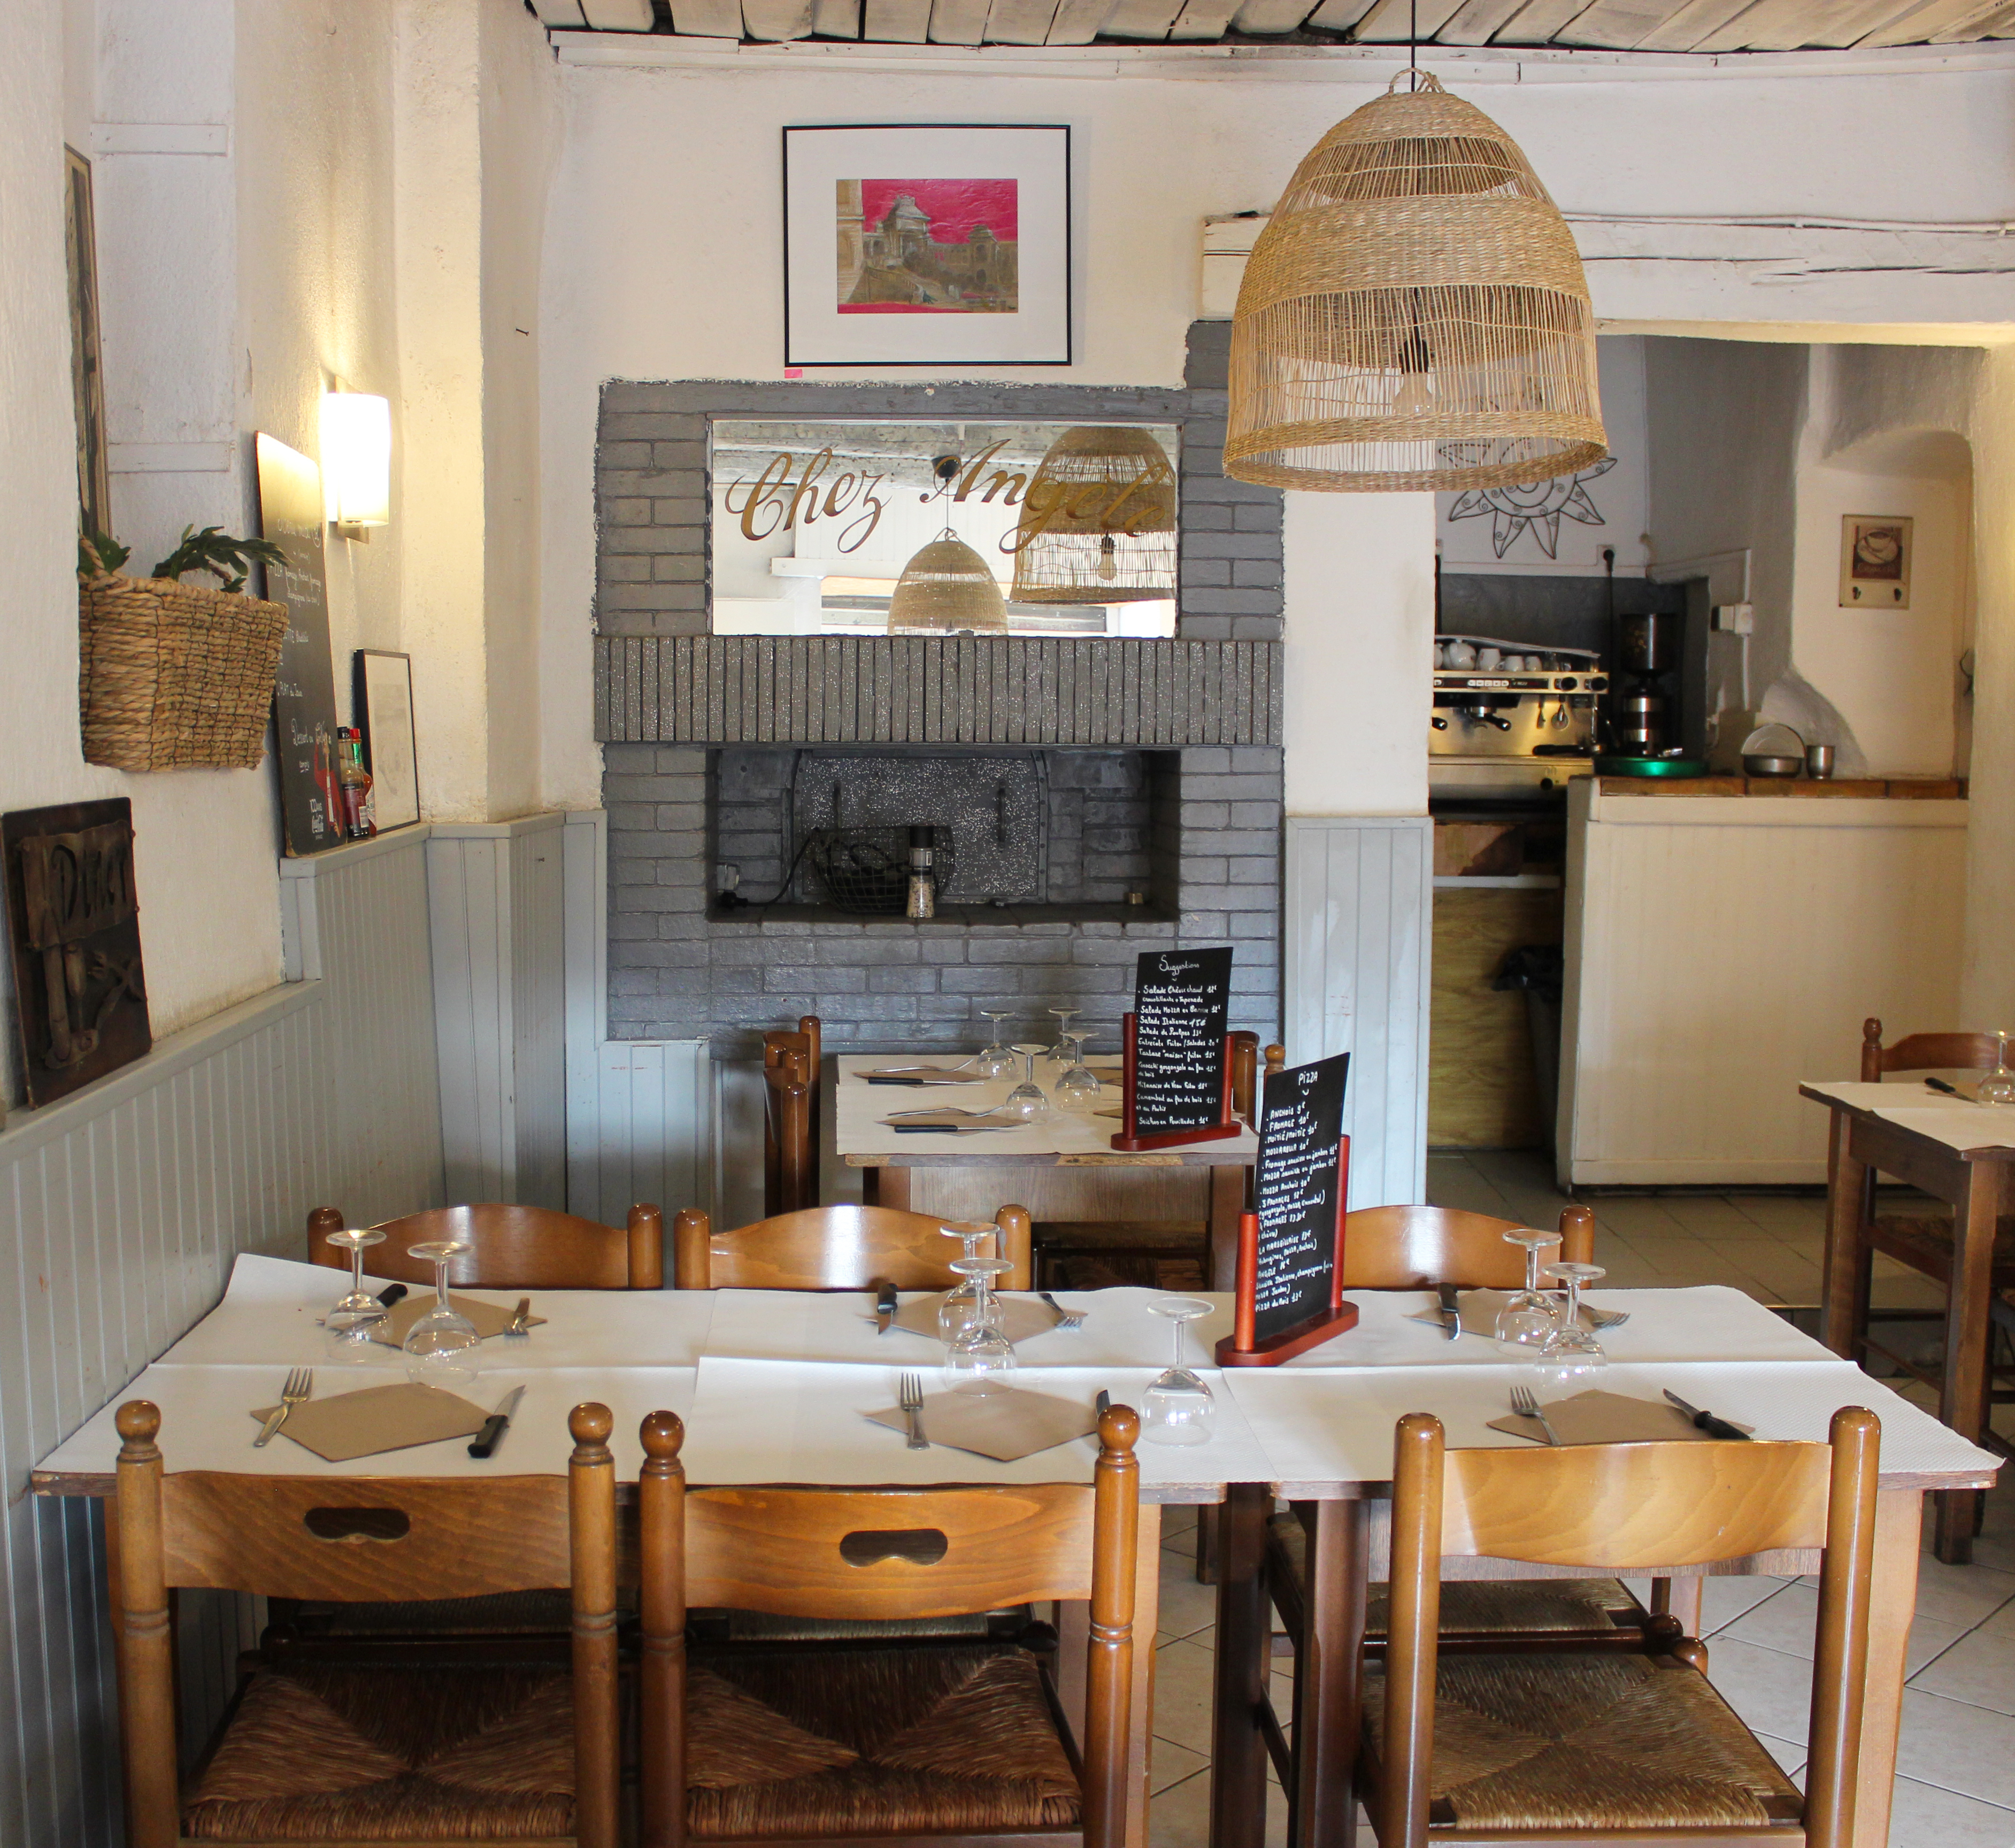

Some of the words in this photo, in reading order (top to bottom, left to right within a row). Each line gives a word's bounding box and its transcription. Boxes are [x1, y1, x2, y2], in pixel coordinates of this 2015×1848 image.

[725, 447, 893, 553] Chez
[1159, 954, 1200, 976] Suggestions
[1143, 985, 1166, 994] Salade
[1187, 984, 1203, 993] chaud
[1140, 1005, 1162, 1014] Salade
[1140, 1015, 1160, 1025] Salade
[1162, 1017, 1188, 1026] Italienne
[1139, 1026, 1159, 1035] Salade
[1196, 1062, 1204, 1074] feu
[1174, 1095, 1183, 1105] feu
[1184, 1095, 1190, 1103] de
[1270, 1119, 1295, 1133] FROMAGE
[1259, 1246, 1265, 1256] LA
